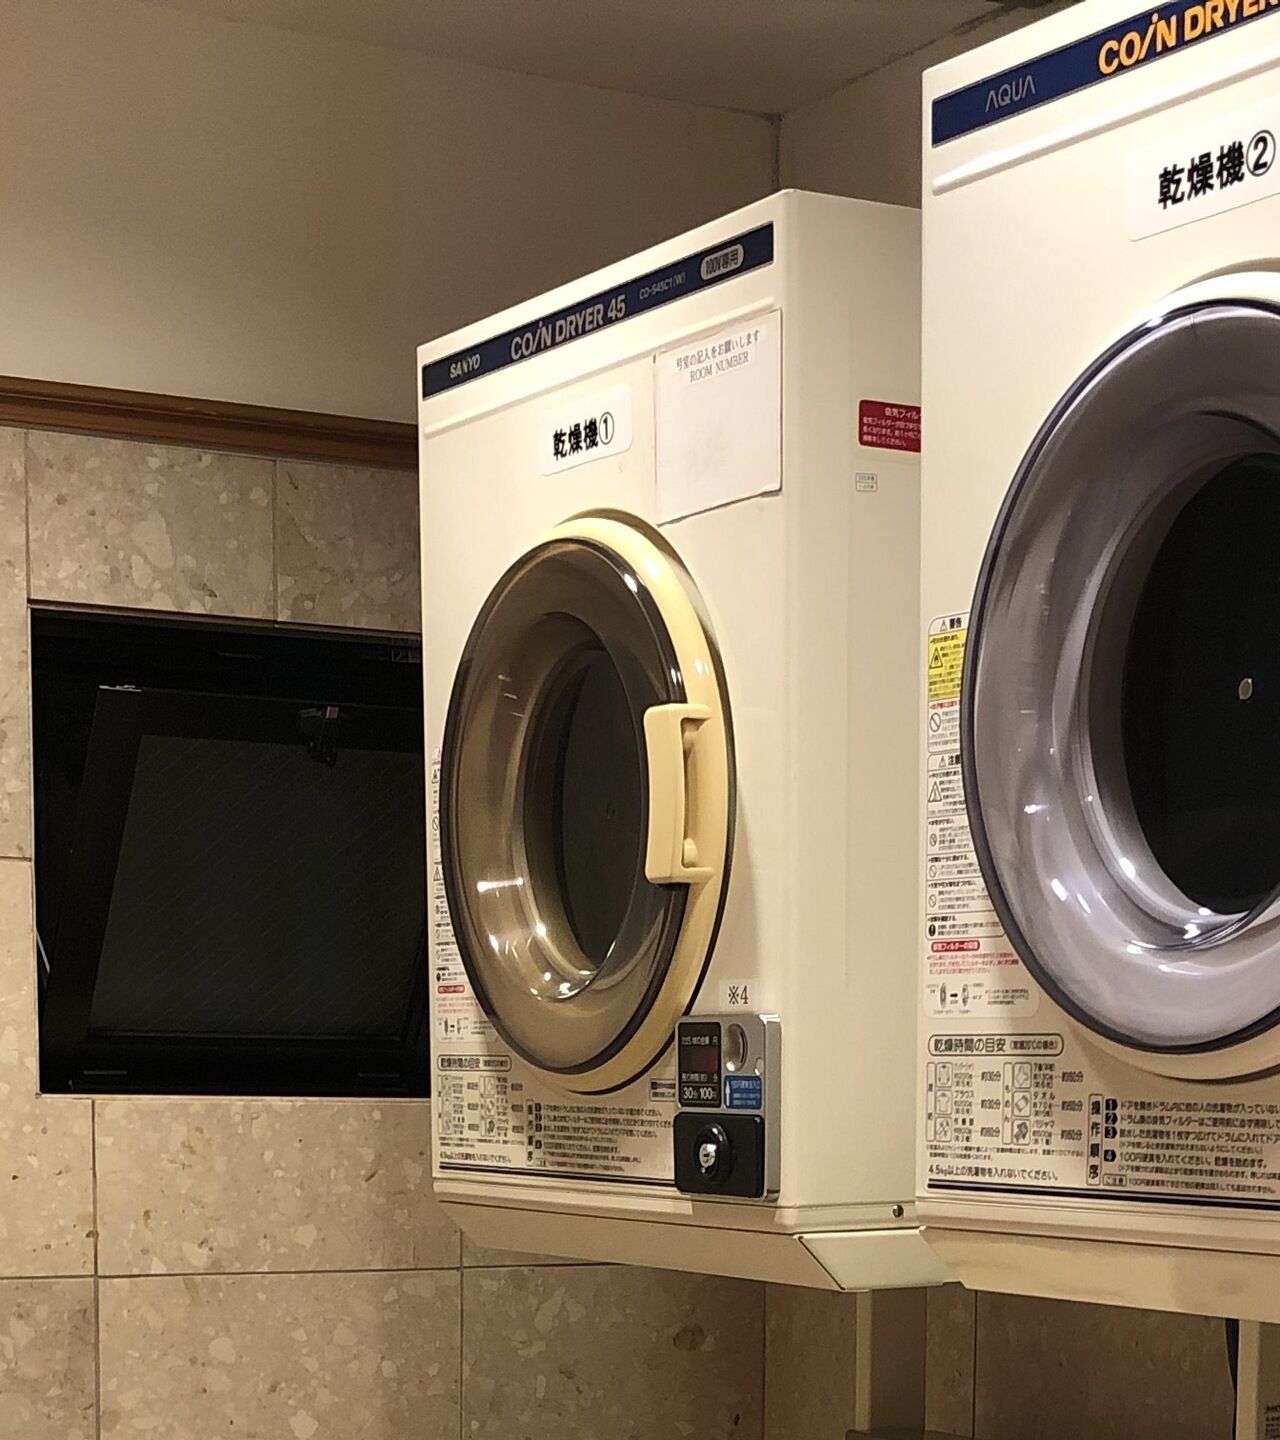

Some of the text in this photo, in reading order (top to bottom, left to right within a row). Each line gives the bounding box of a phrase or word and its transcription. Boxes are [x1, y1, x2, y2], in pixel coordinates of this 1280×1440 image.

[984, 76, 1037, 114] AQUA
[1157, 128, 1277, 212] 乾燥機②
[555, 303, 604, 344] DRYER
[607, 294, 626, 321] 45
[449, 353, 481, 379] SANYO
[676, 329, 761, 371] 号室の記入をお願いします
[689, 350, 750, 383] ROOM NUMBER
[551, 410, 615, 461] 乾燥機①
[933, 1037, 1007, 1053] 乾燥時間の目安
